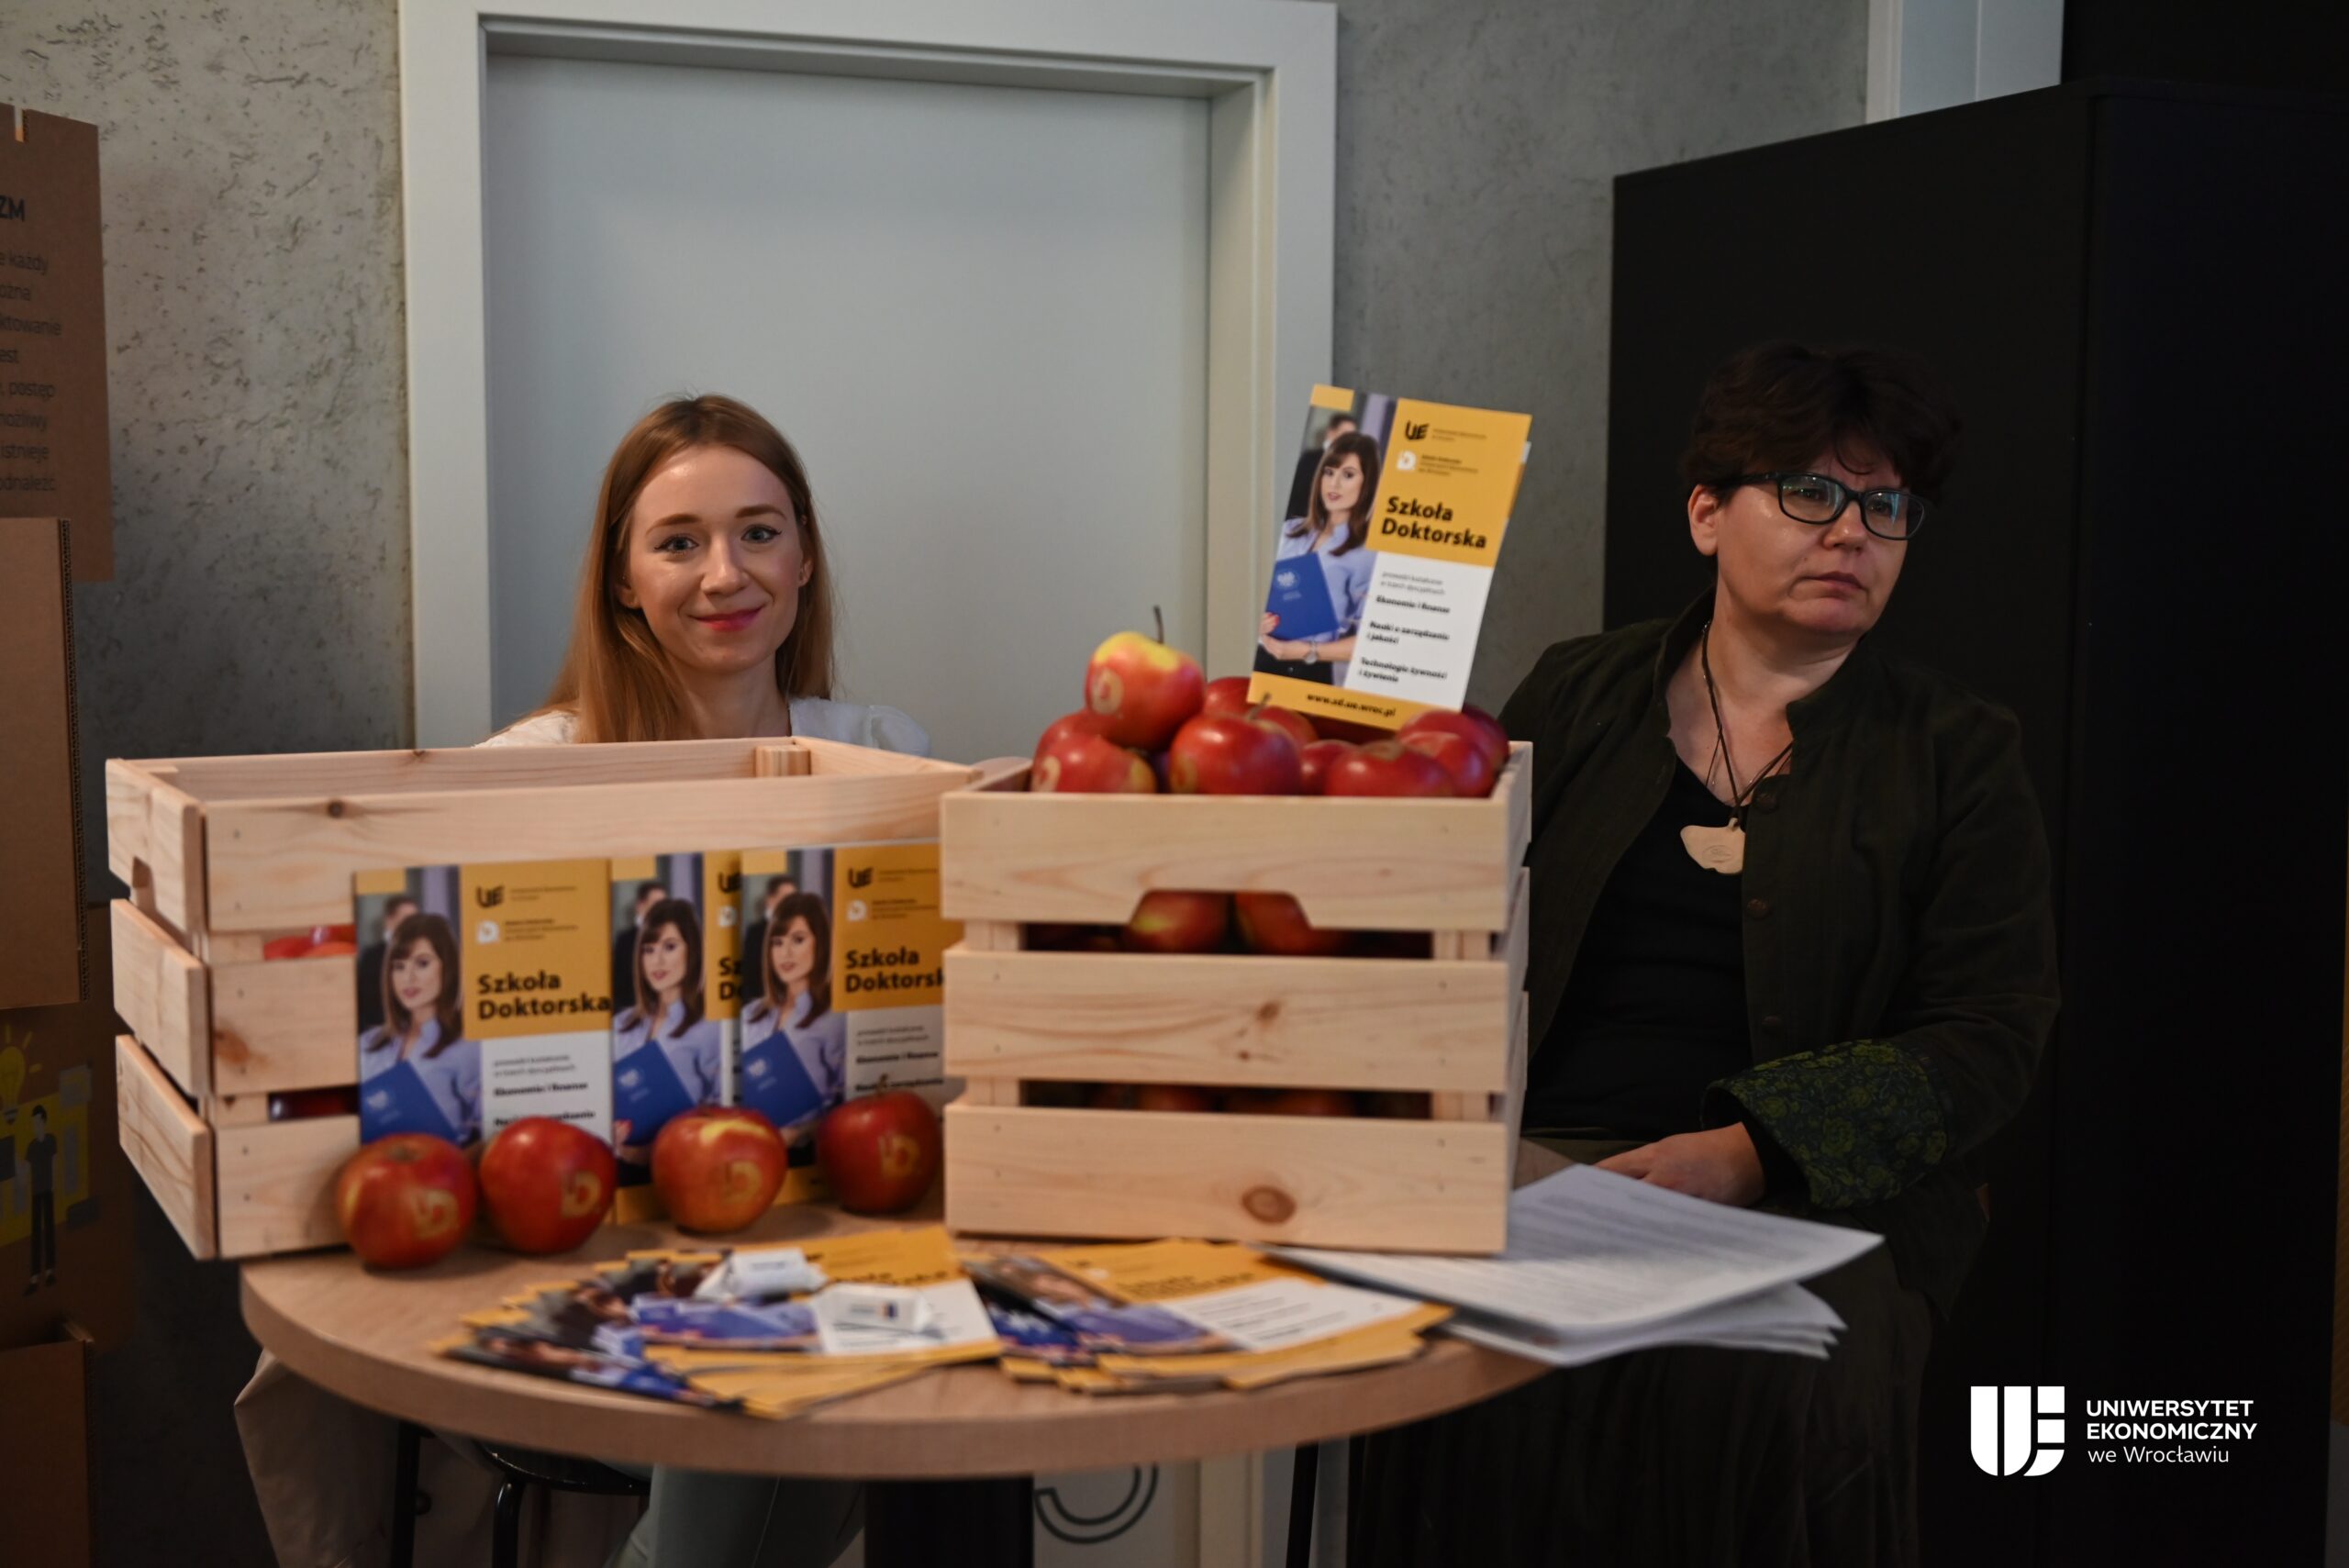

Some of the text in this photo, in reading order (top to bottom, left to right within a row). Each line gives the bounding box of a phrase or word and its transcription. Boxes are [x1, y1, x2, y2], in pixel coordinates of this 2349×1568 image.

[1386, 495, 1453, 522] Szkoła
[1381, 517, 1487, 550] Doktorska
[846, 946, 919, 969] Szkoła
[478, 969, 561, 995] Szkoła
[478, 992, 612, 1020] Doktorska
